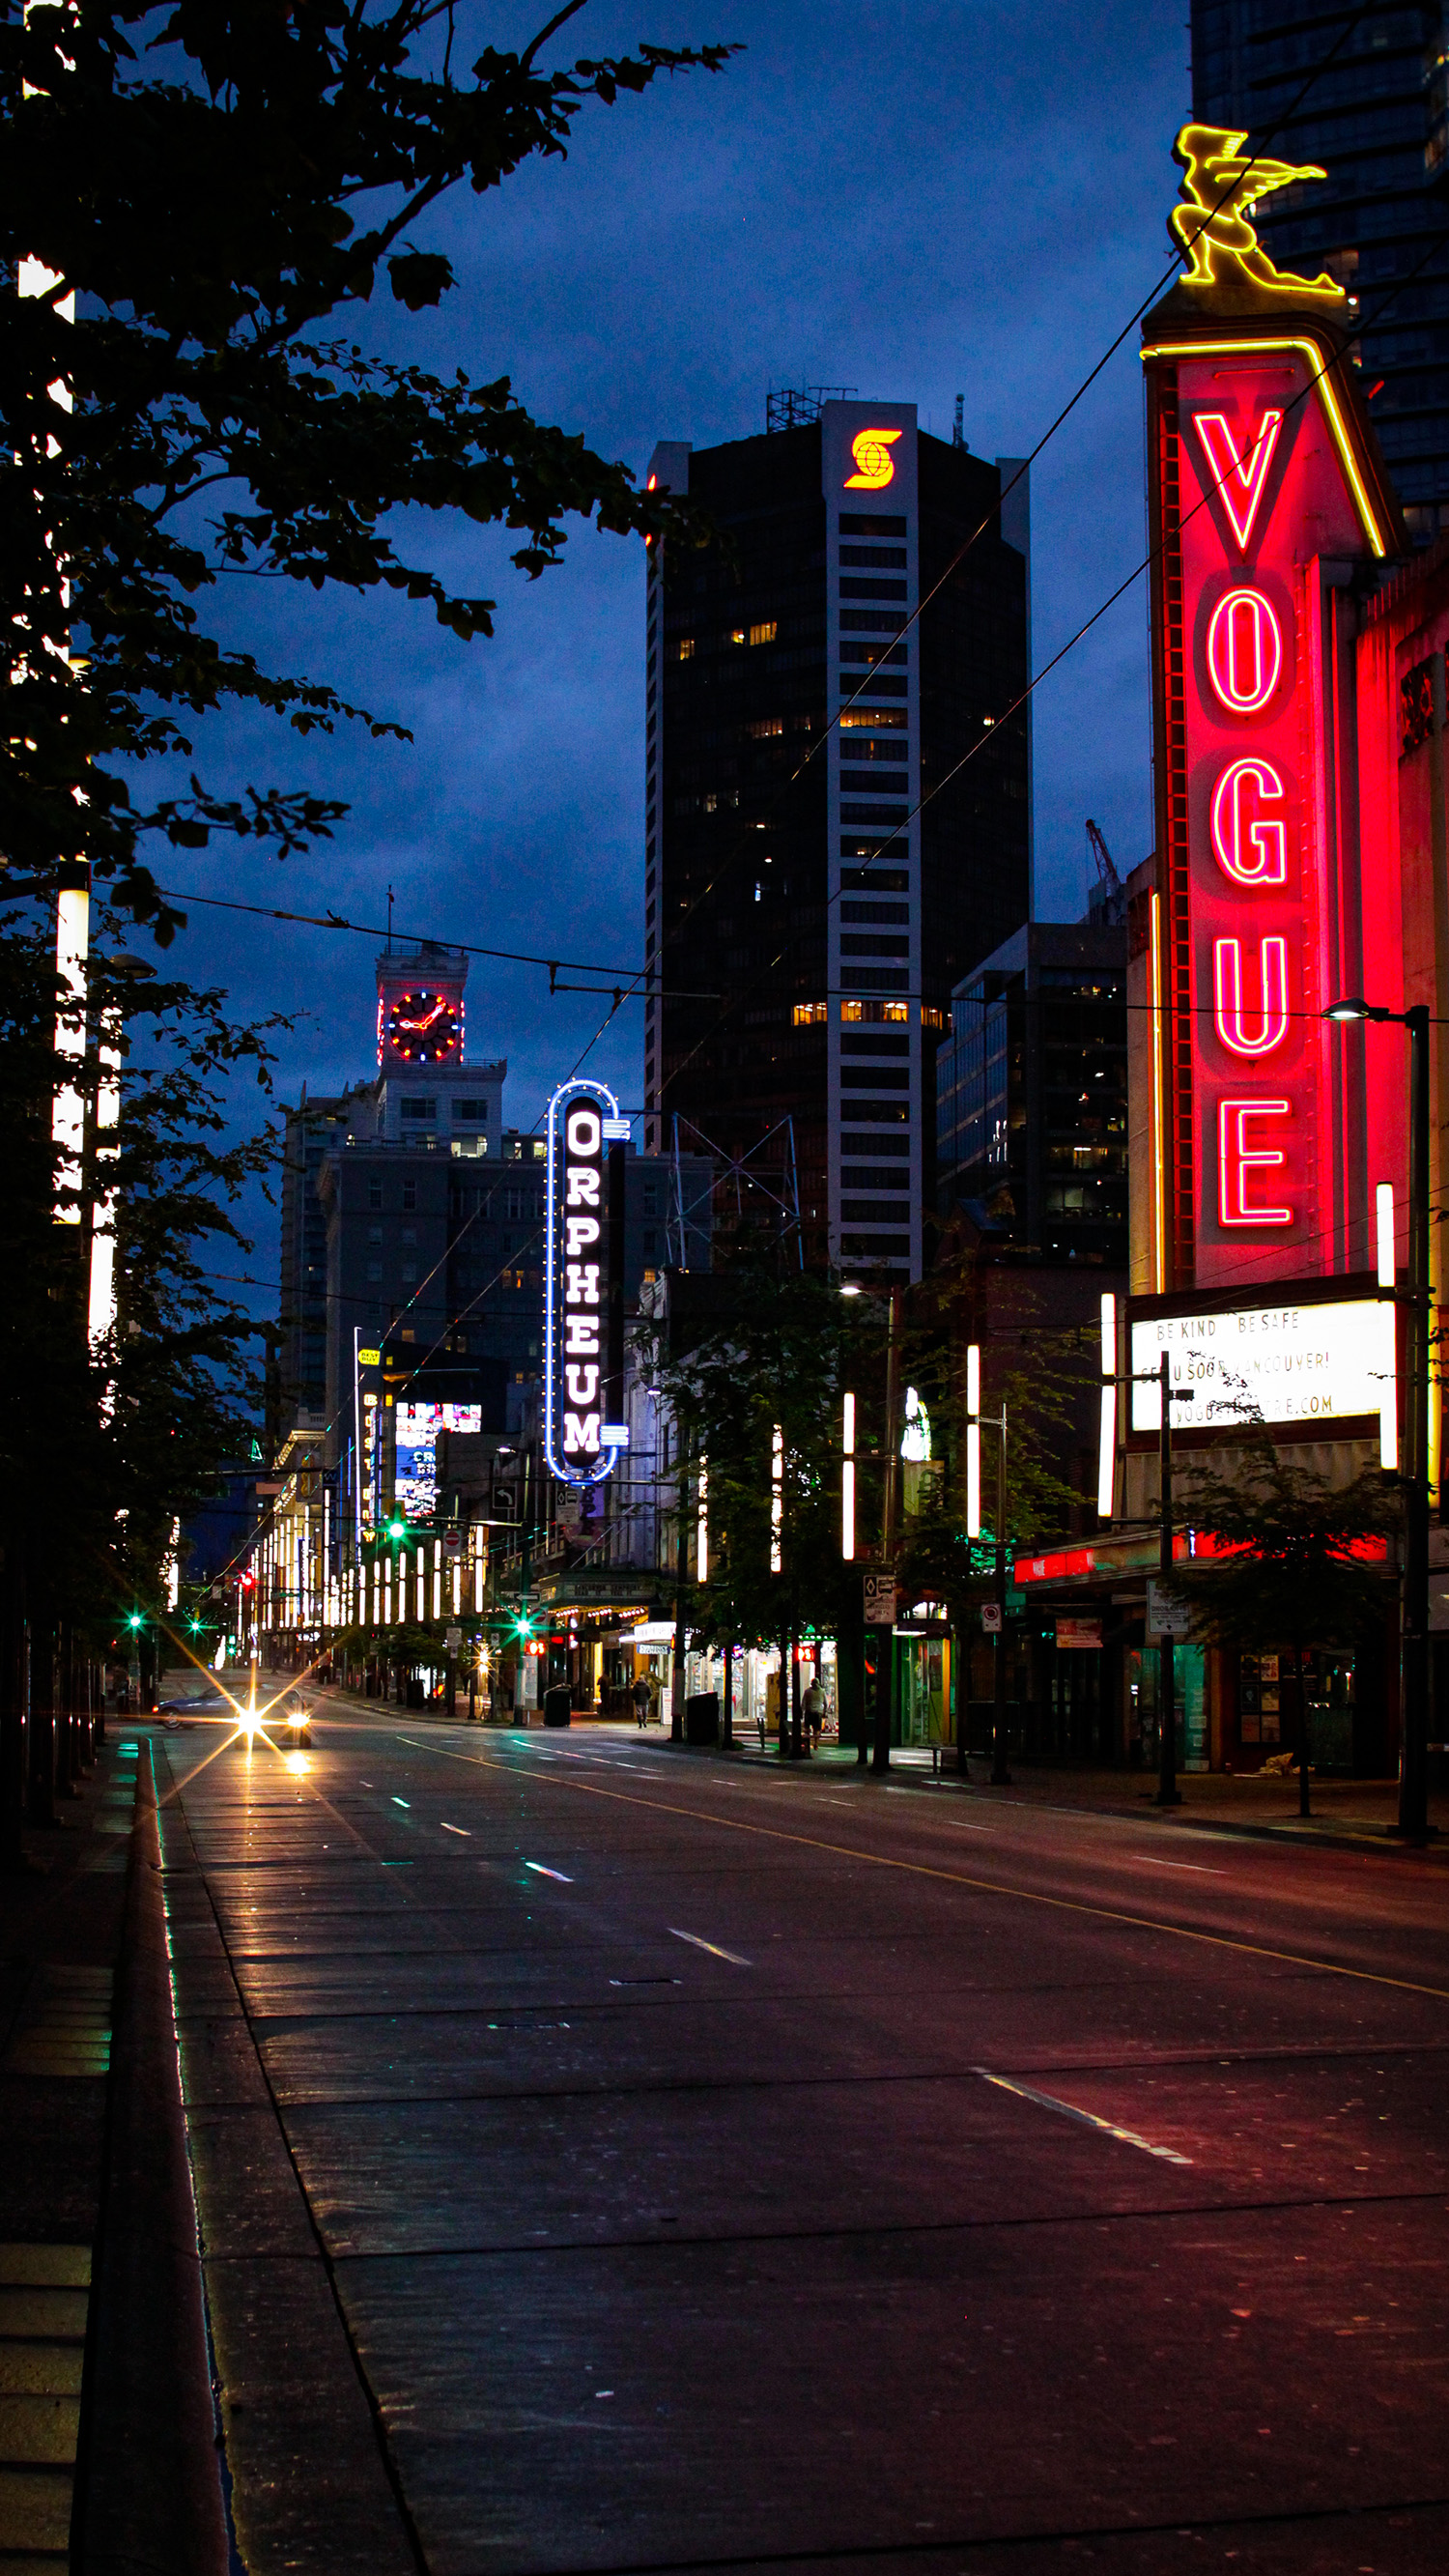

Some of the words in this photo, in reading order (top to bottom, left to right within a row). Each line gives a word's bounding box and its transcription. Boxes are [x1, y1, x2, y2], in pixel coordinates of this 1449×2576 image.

[1192, 410, 1294, 1229] VOGUE
[563, 1109, 601, 1453] ORPHEUM
[1156, 1323, 1175, 1341] BE
[1180, 1320, 1216, 1339] KIND
[1237, 1316, 1256, 1333] BE
[1261, 1311, 1299, 1331] SAFE
[1173, 1364, 1182, 1382] U
[1233, 1352, 1330, 1375] VANCOUVER!
[1176, 1394, 1333, 1424] VOGUTRE.COM
